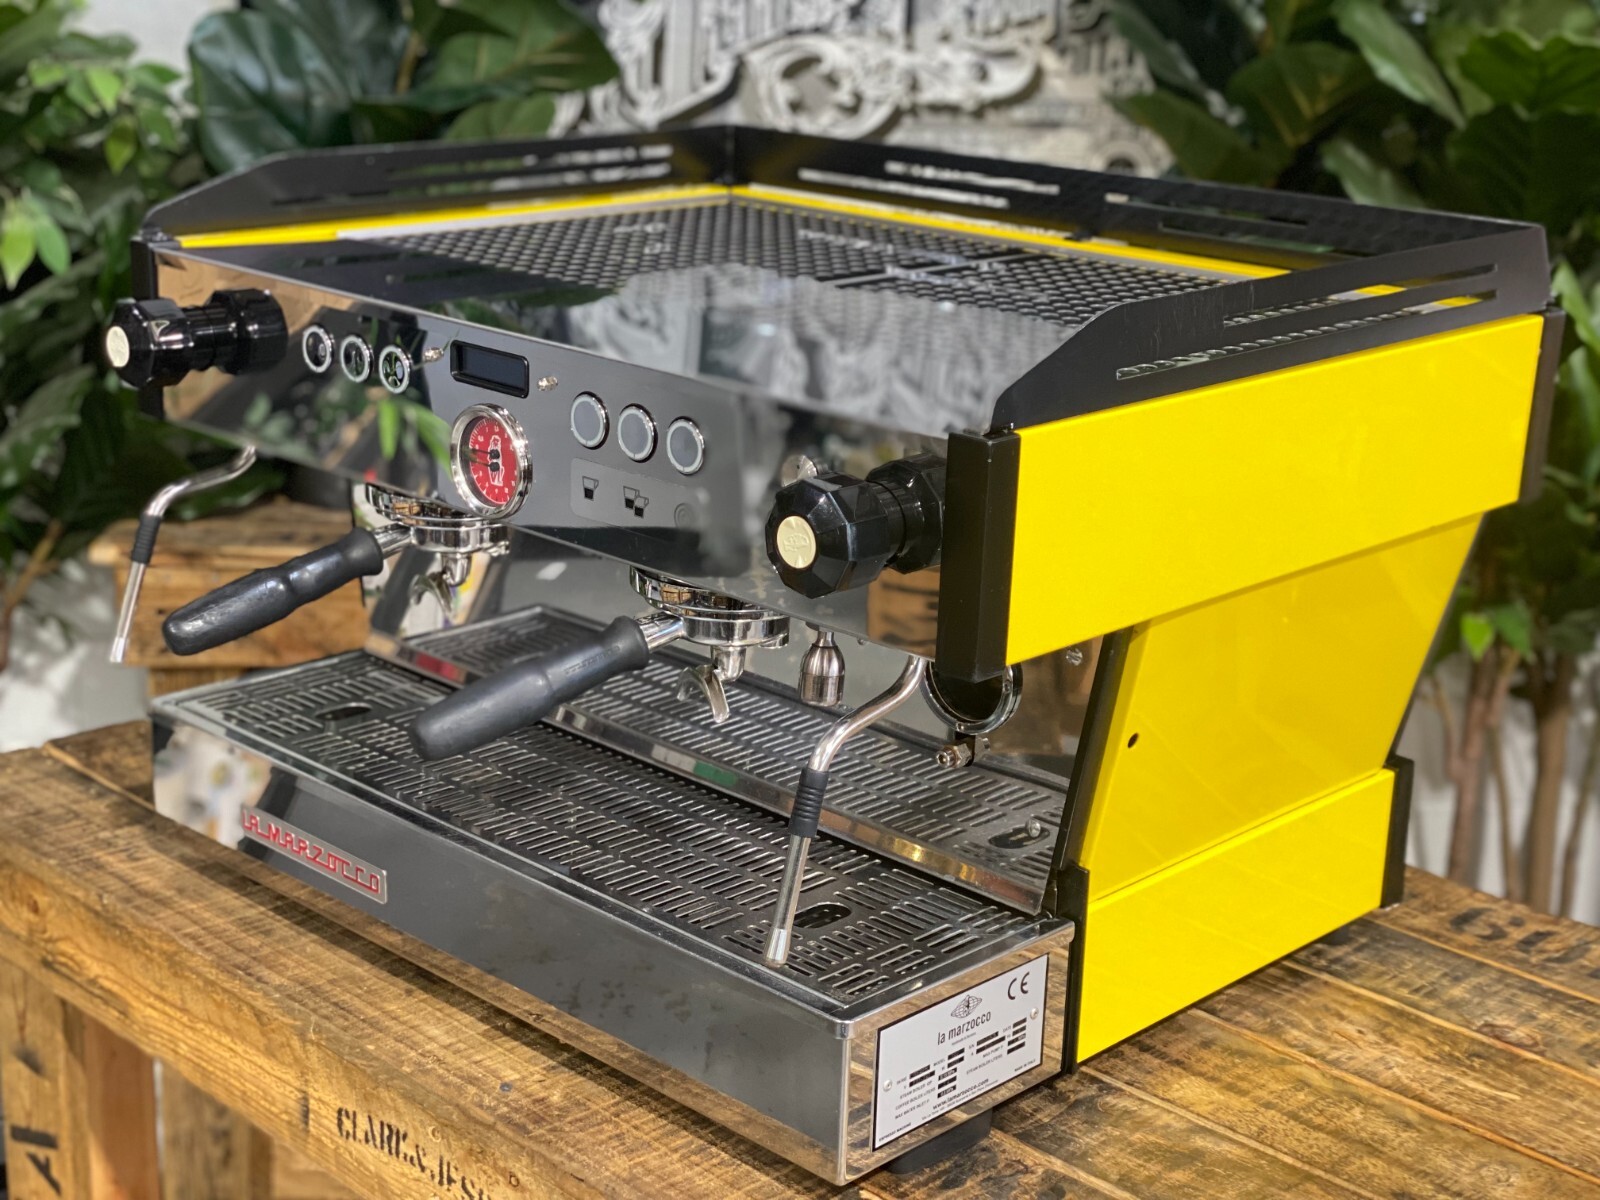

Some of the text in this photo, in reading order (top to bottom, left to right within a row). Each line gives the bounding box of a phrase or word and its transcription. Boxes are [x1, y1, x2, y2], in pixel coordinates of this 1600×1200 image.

[267, 823, 381, 894] MARZOCCO
[1008, 971, 1030, 1000] CE
[937, 1031, 946, 1046] la
[948, 1011, 991, 1041] marzocco
